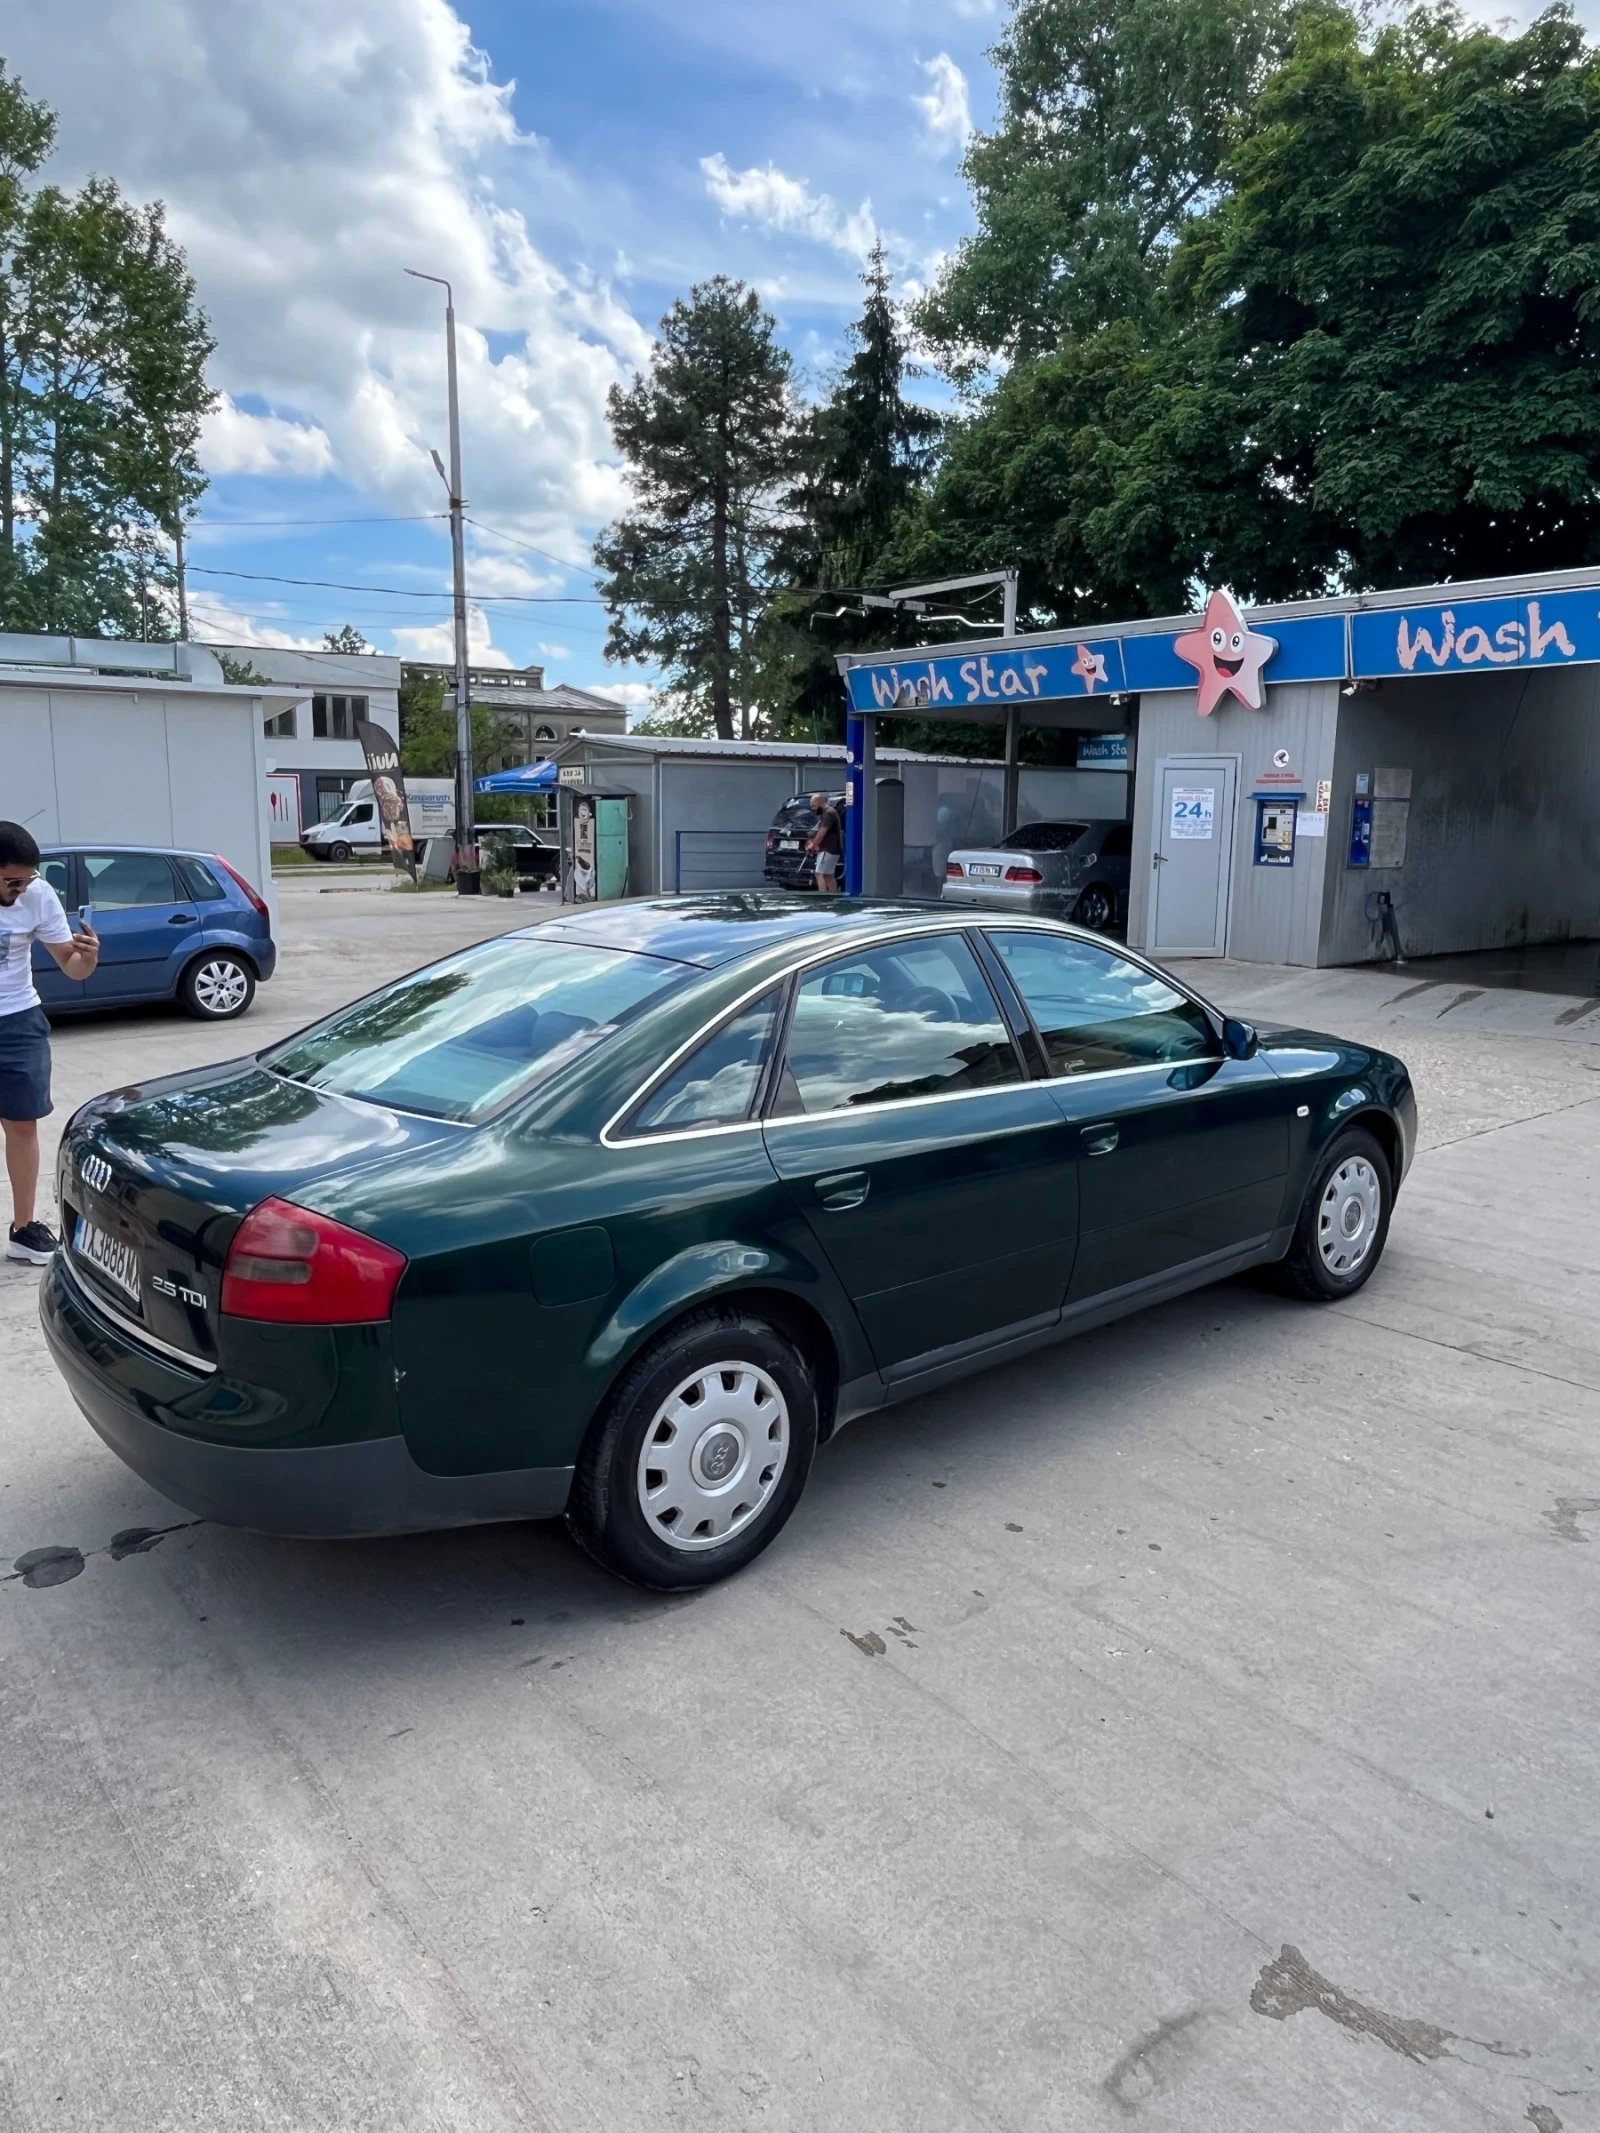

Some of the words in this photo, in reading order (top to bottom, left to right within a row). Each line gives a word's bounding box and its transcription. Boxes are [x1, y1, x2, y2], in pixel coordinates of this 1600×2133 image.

[1397, 601, 1576, 670] Wash
[960, 657, 1048, 702] Star
[1082, 743, 1109, 756] Wash
[1110, 742, 1127, 756] Sta
[179, 1286, 206, 1309] TDI
